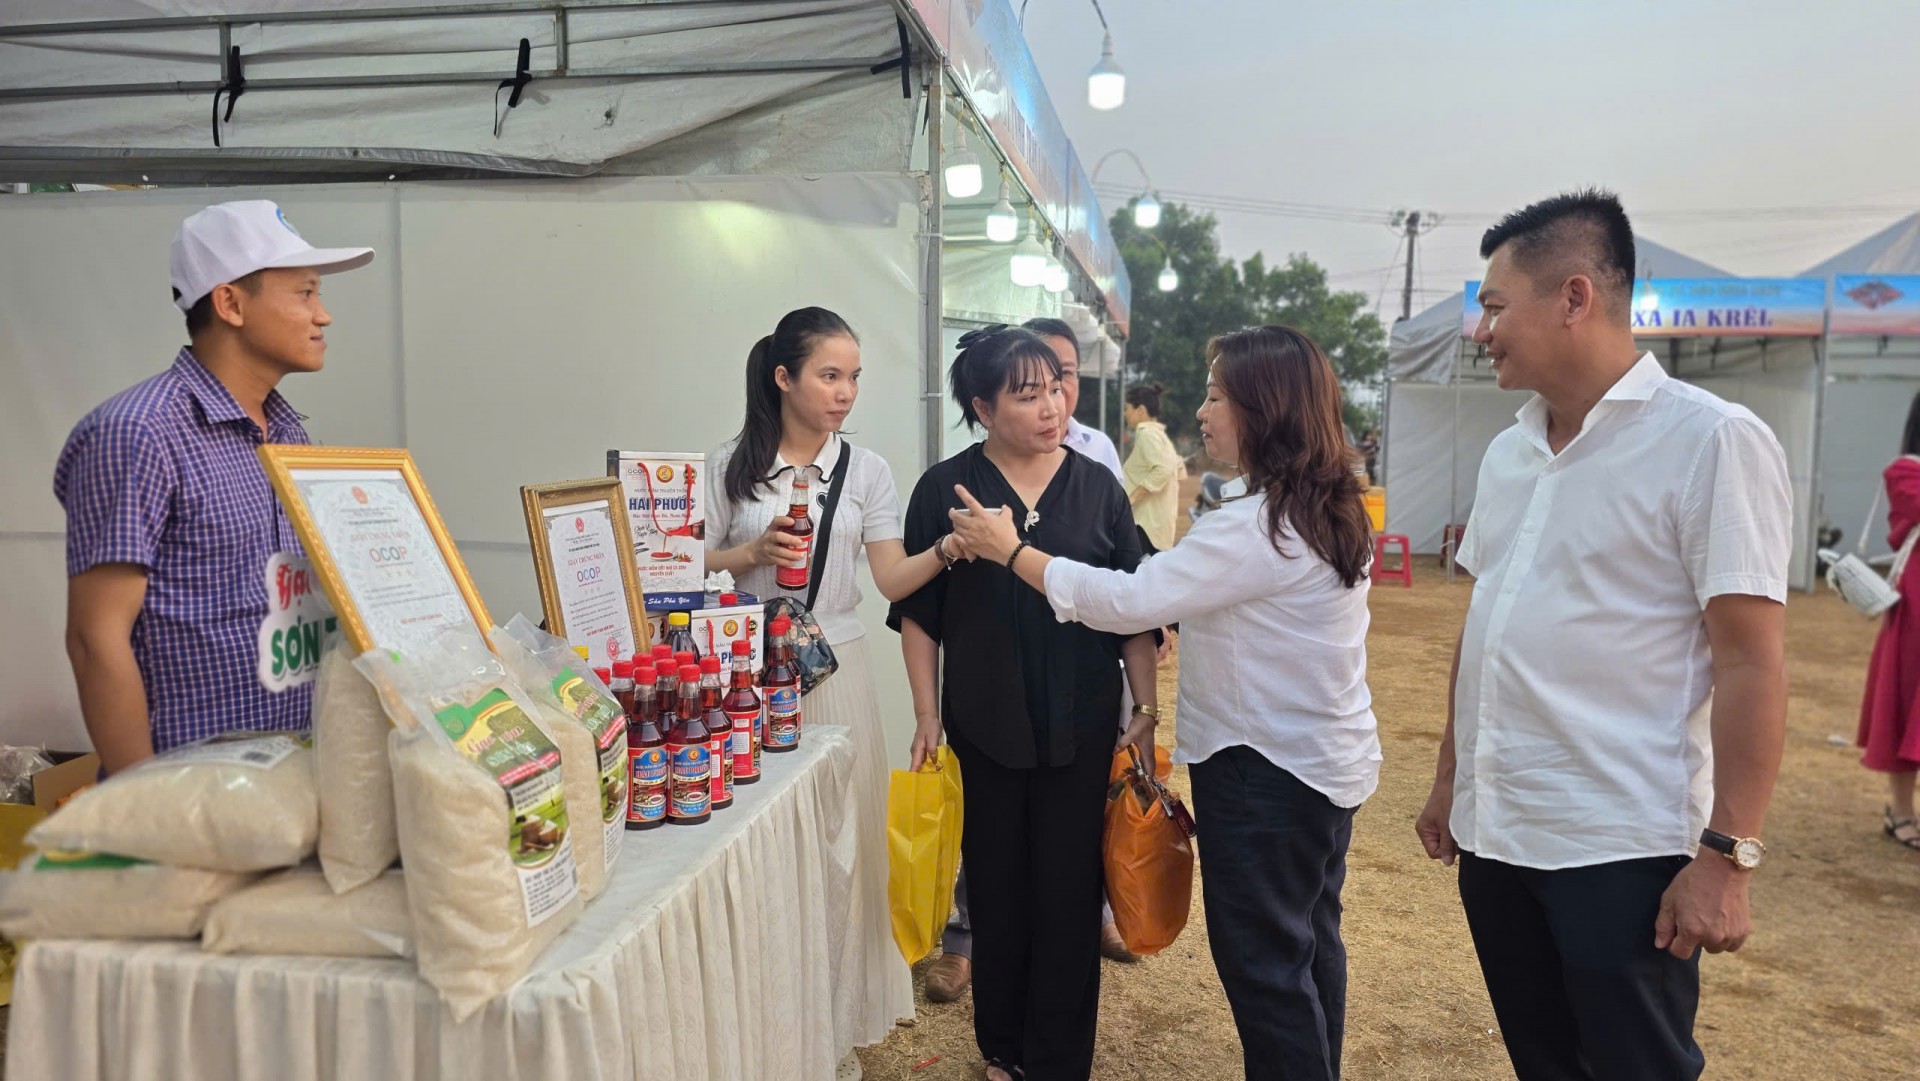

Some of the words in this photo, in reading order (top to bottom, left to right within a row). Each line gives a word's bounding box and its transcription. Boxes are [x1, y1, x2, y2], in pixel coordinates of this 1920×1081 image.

[1673, 309, 1696, 327] IA
[369, 546, 407, 562] OCOP
[577, 567, 601, 582] OCOP
